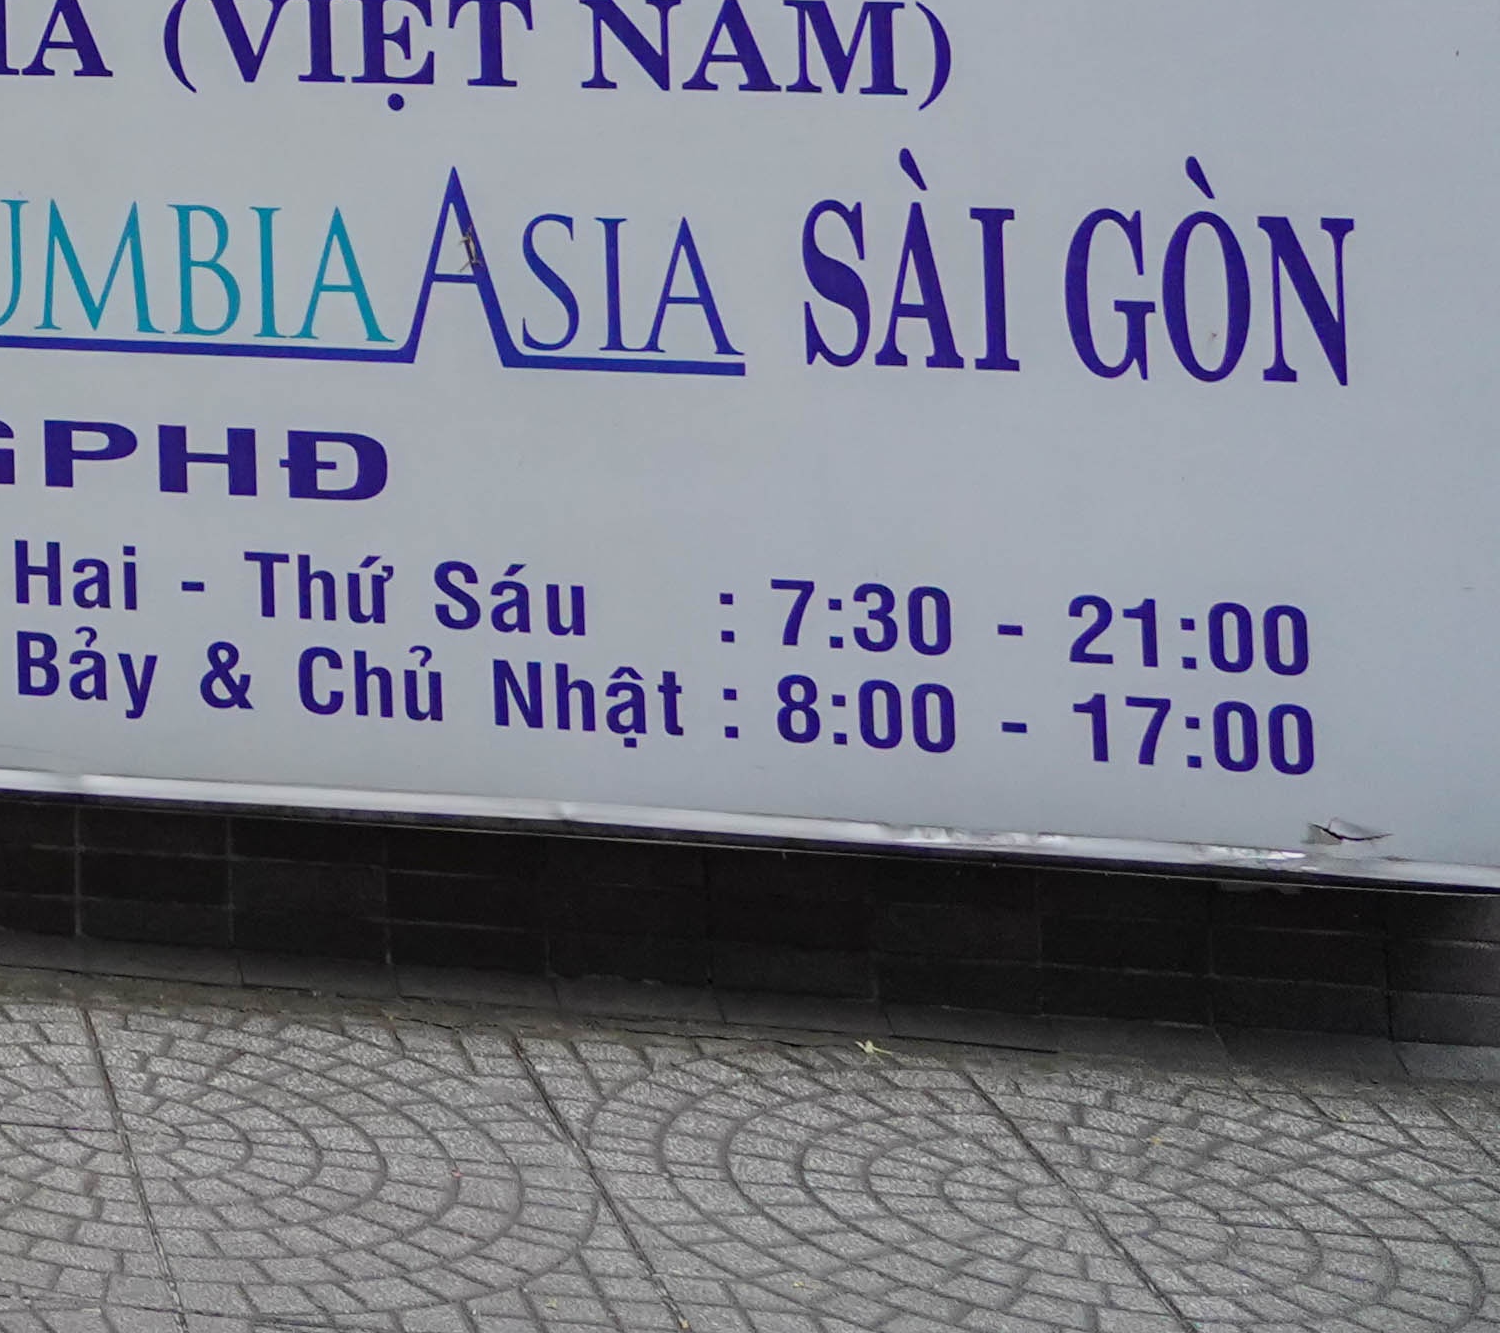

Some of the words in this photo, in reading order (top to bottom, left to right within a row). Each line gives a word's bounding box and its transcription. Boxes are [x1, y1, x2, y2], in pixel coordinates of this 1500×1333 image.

[802, 147, 1021, 372] SÀI
[1064, 156, 1355, 387] GÒN
[14, 539, 138, 611] Hai
[243, 551, 394, 625] Thứ
[434, 560, 586, 637] Sáu
[770, 578, 952, 656] 7:30
[1068, 594, 1309, 676] 21:00
[16, 626, 158, 720] Bảy
[199, 641, 254, 710] &
[298, 645, 444, 722] Chủ
[493, 658, 684, 749] Nhật
[776, 674, 956, 754] 8:00
[1072, 693, 1315, 776] 17:00
